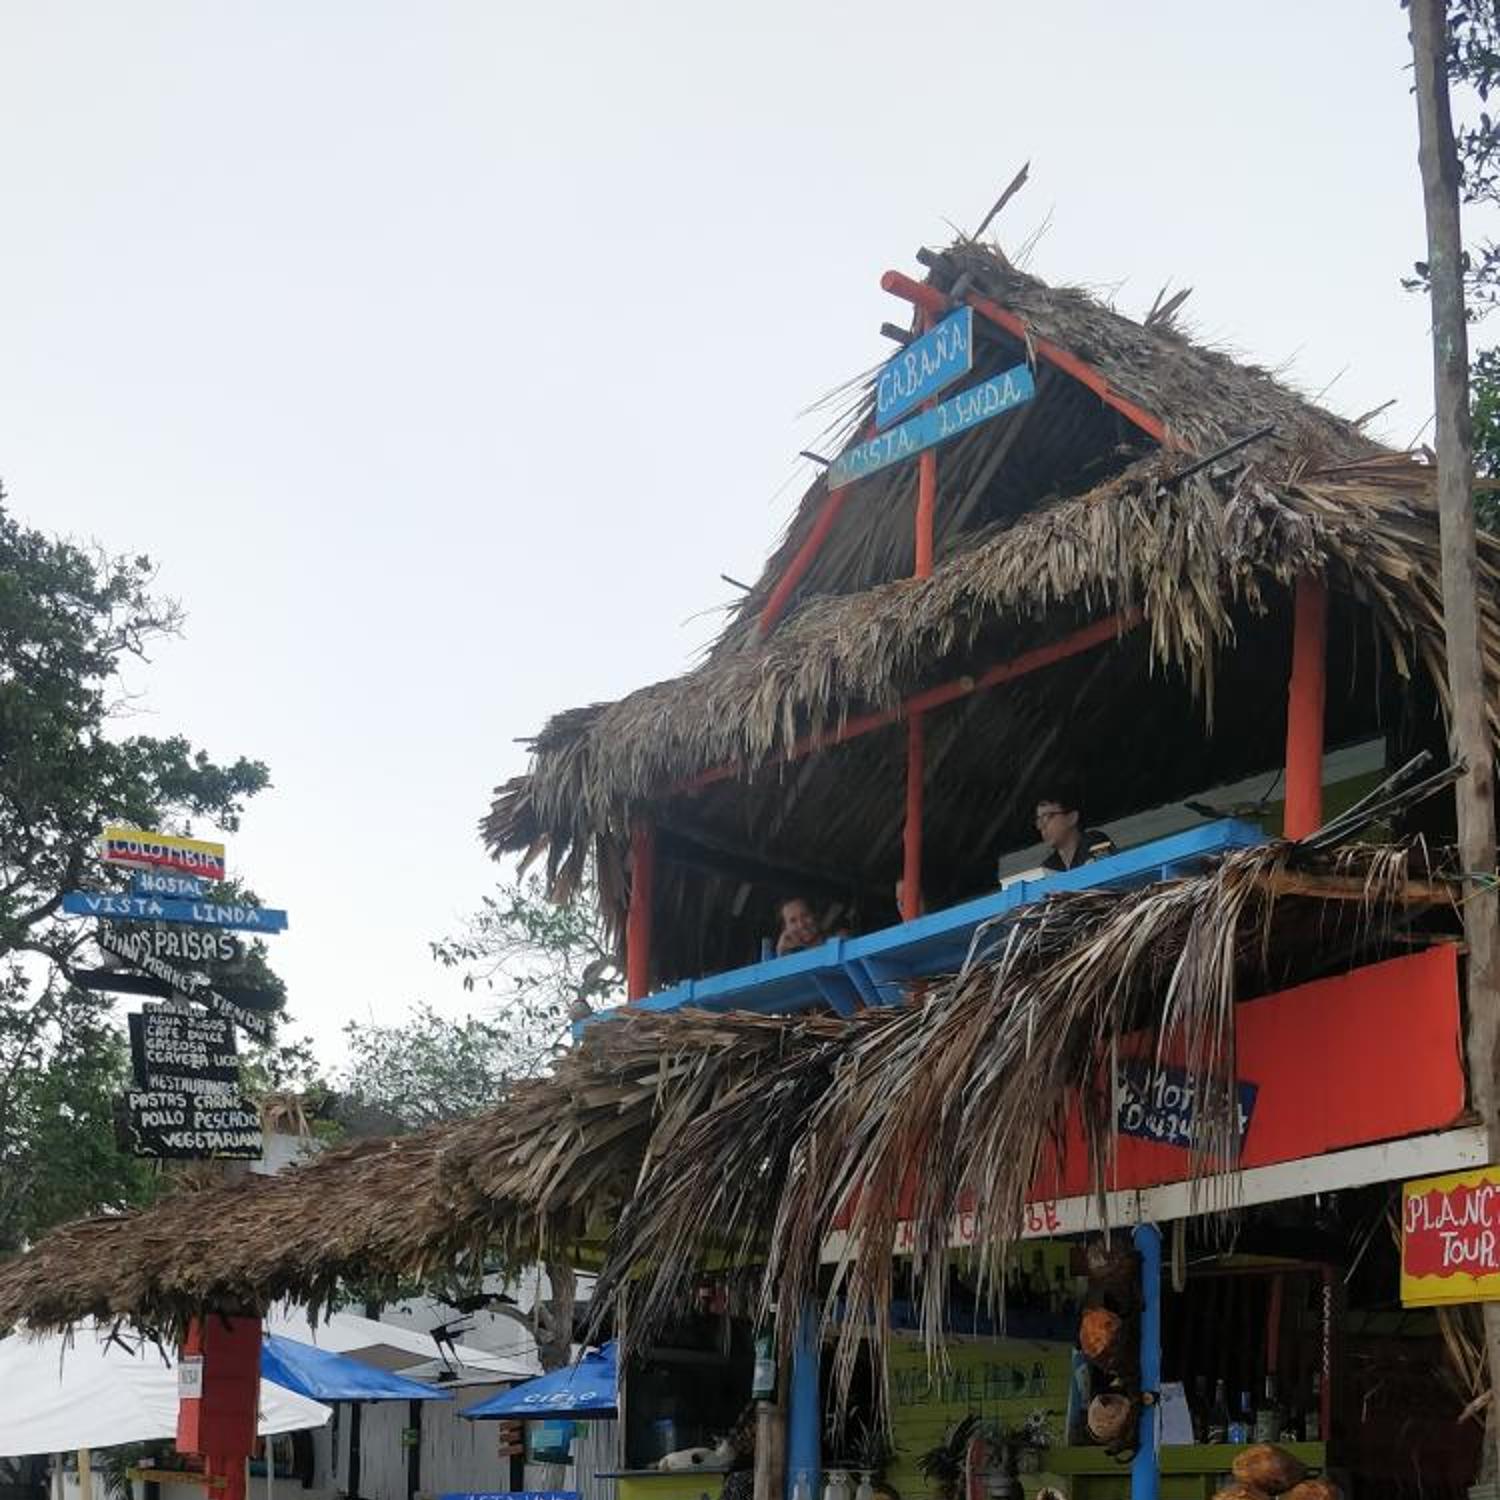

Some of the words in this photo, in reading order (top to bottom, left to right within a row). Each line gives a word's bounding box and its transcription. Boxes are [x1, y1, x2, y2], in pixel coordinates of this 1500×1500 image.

[878, 322, 967, 412] CABAÑA
[937, 374, 1021, 434] LINDA
[113, 840, 219, 870] COLOMBIA
[141, 873, 203, 895] HOSTAL
[85, 897, 163, 915] VISTA
[192, 903, 260, 923] LINDA
[211, 991, 266, 1034] TIENDA
[129, 1093, 187, 1110] PASTAS
[141, 1111, 185, 1128] POLLO
[1406, 1185, 1500, 1233] PLANC
